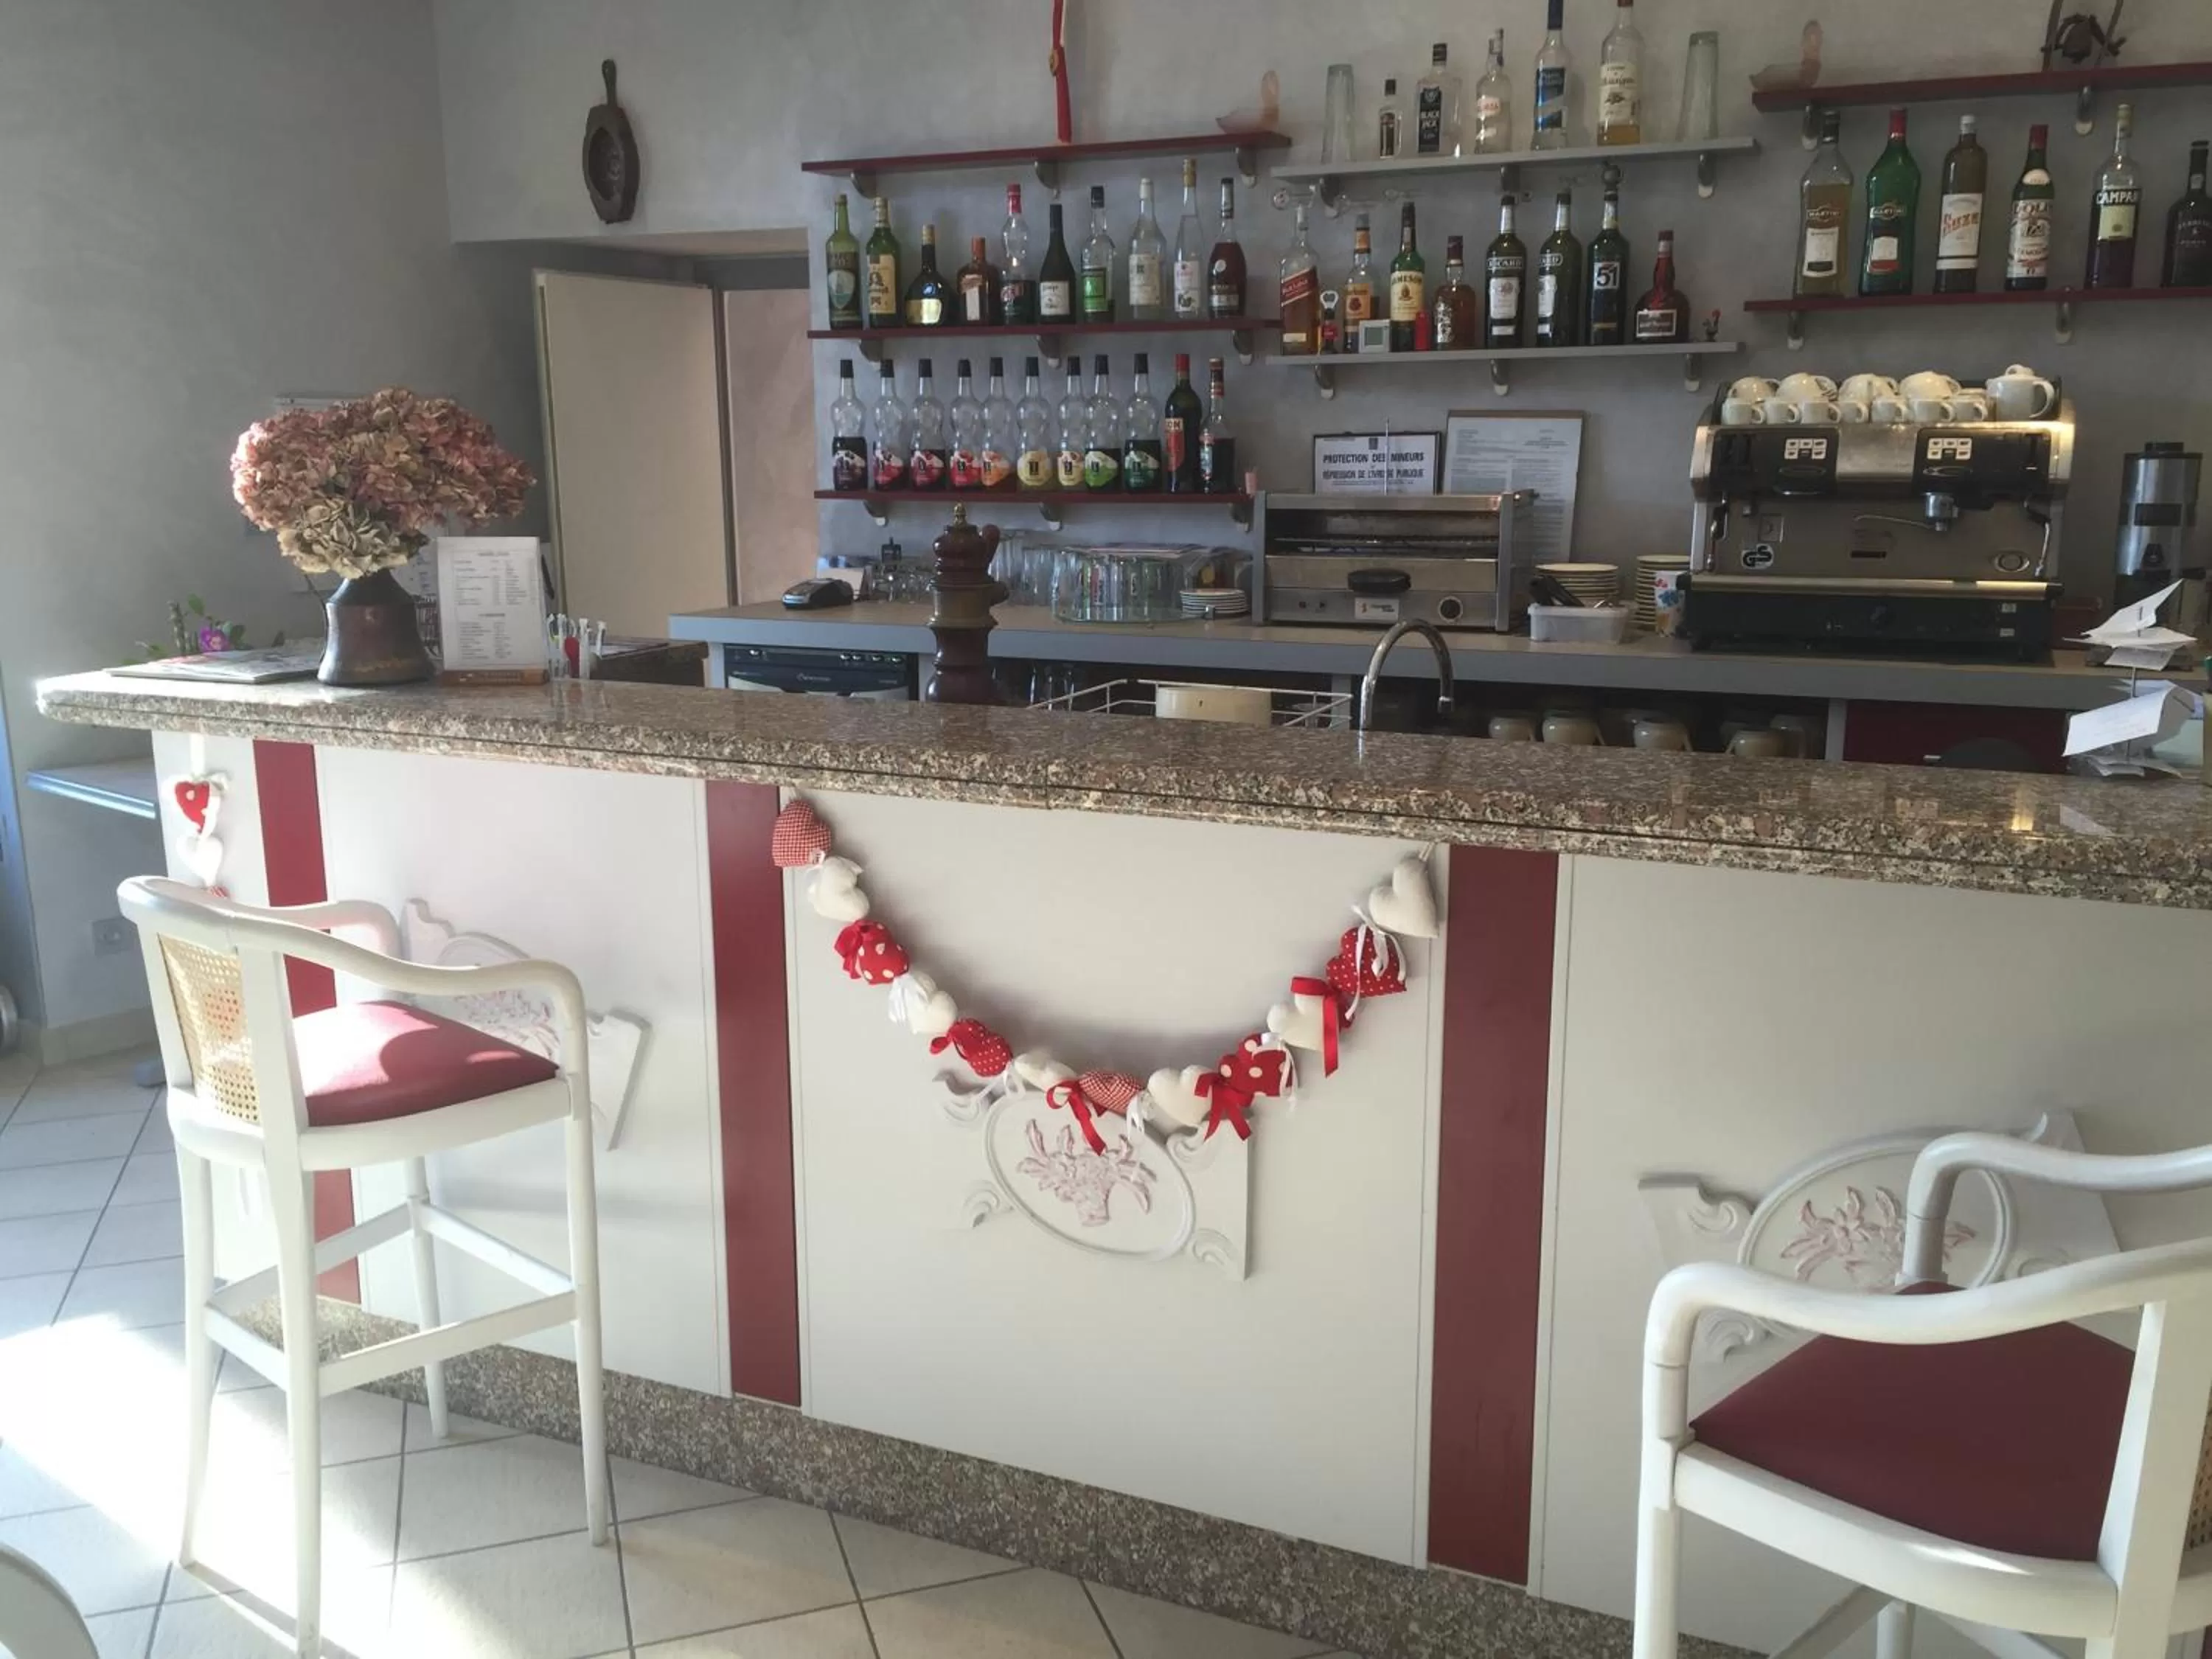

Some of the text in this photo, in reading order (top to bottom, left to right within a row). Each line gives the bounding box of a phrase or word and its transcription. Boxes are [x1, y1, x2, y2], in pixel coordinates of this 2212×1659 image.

[2096, 190, 2138, 205] CAMPAR
[1596, 266, 1618, 287] 51
[1323, 453, 1368, 464] PROTECTION
[1391, 452, 1425, 462] MINEURS
[1357, 470, 1366, 479] DE
[1368, 469, 1394, 479] L'IVRESE
[1396, 468, 1425, 479] PUBLIQUE
